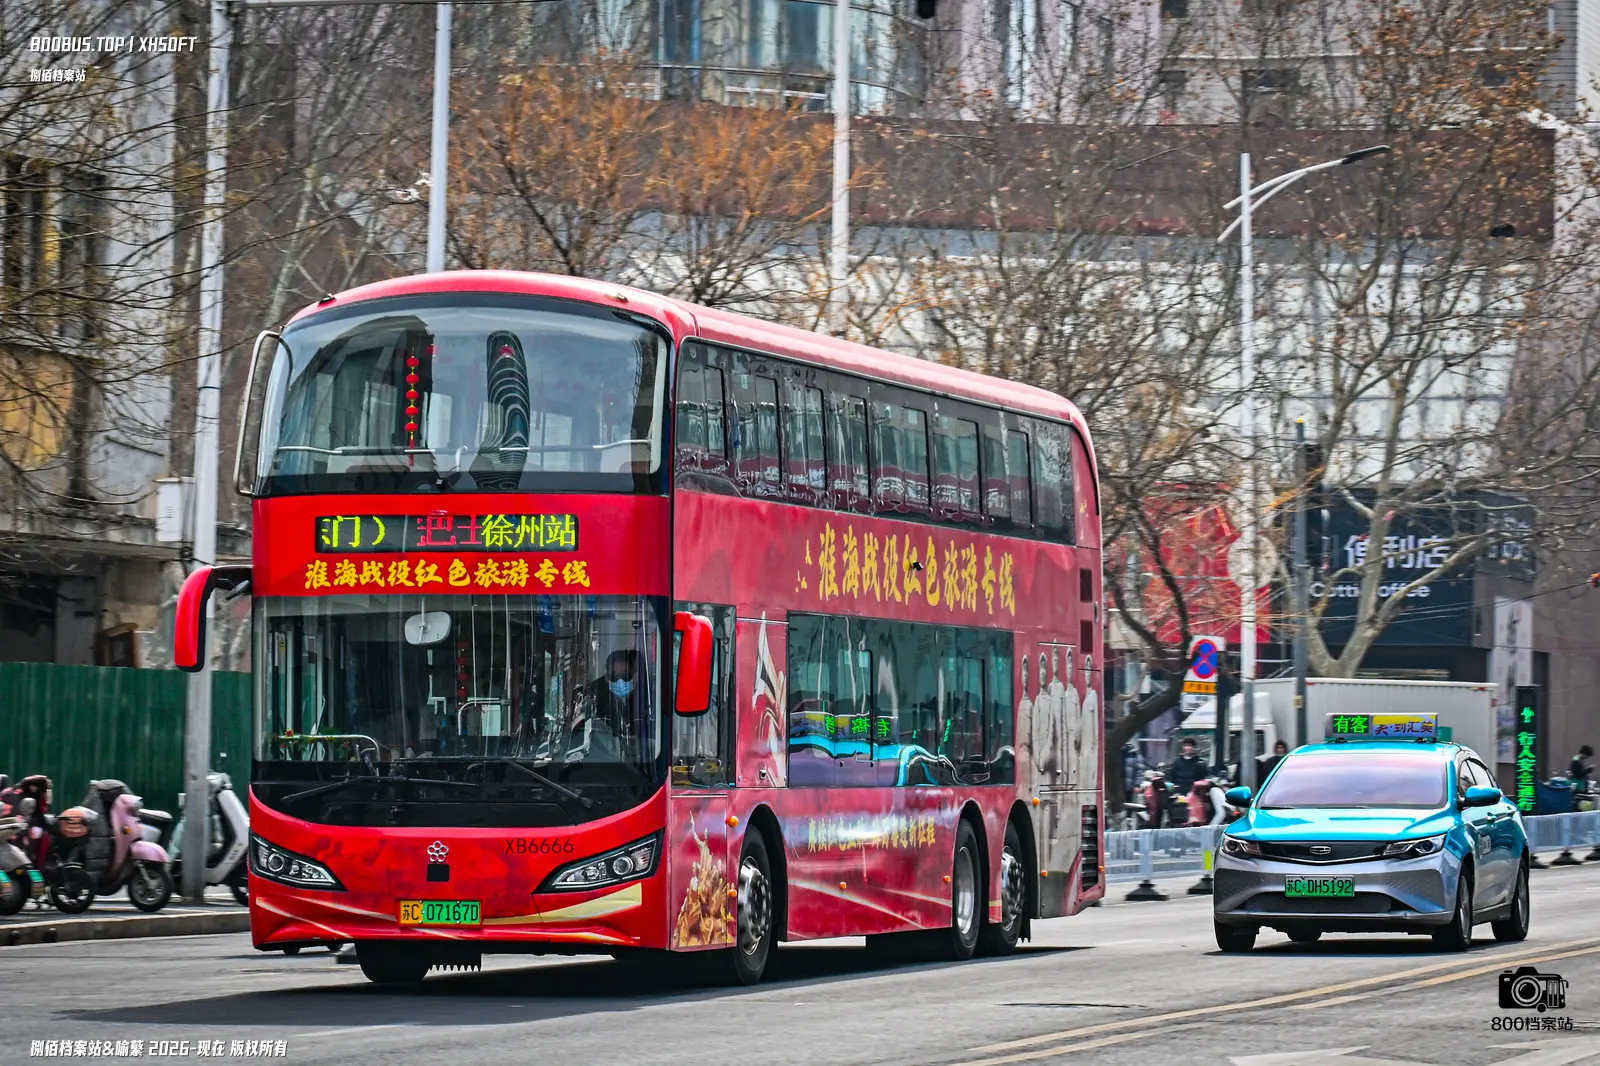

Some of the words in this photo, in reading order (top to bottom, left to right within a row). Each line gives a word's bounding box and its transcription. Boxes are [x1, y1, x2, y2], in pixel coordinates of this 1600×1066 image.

[481, 513, 576, 548] 徐州站
[1344, 534, 1451, 569] 便利店
[304, 558, 591, 588] 淮海战役红色旅游专线
[818, 522, 1015, 617] 淮海战役红色旅游专线
[1309, 582, 1359, 598] Ctti
[1333, 715, 1369, 734] 有客
[505, 838, 575, 855] XB6666
